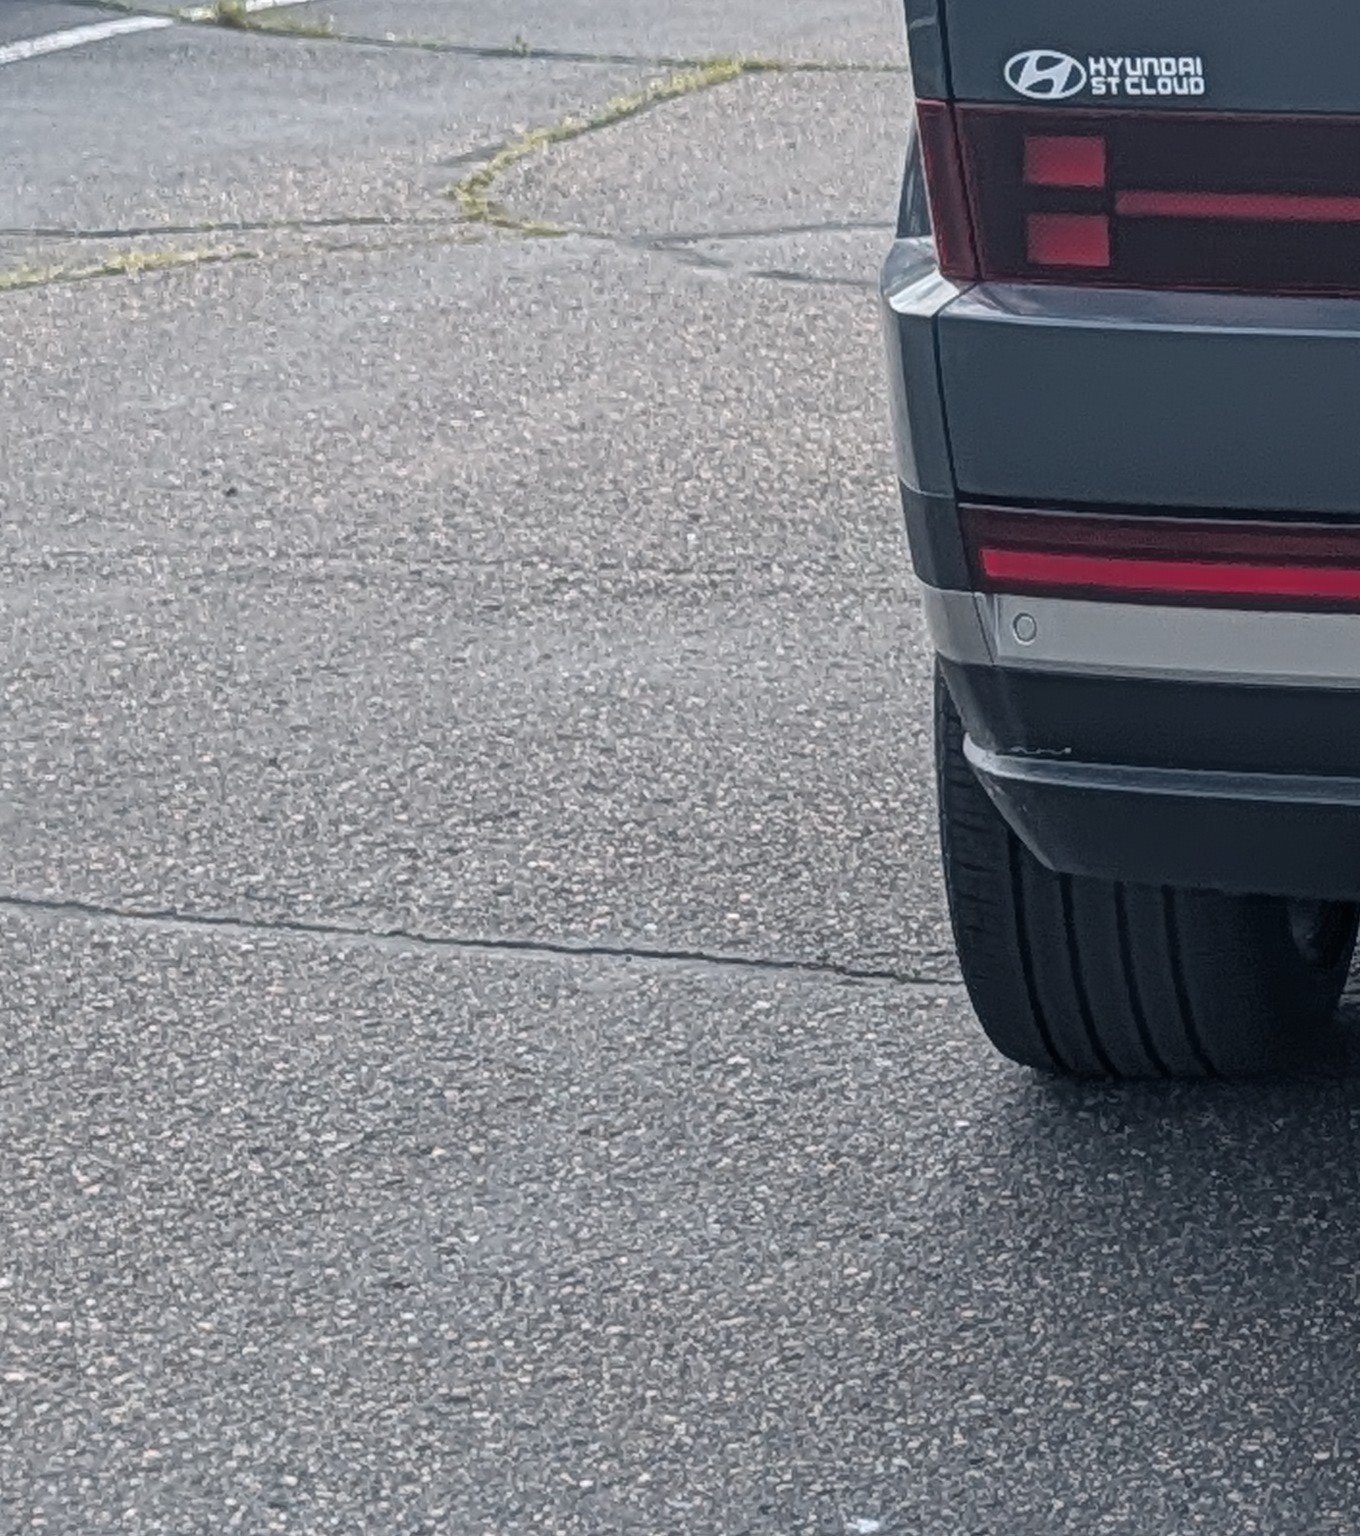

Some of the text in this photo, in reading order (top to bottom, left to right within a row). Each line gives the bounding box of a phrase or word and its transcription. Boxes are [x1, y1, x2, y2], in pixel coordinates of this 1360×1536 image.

[1088, 56, 1204, 77] HYUNDAI
[1091, 77, 1205, 96] ST CLOUD
